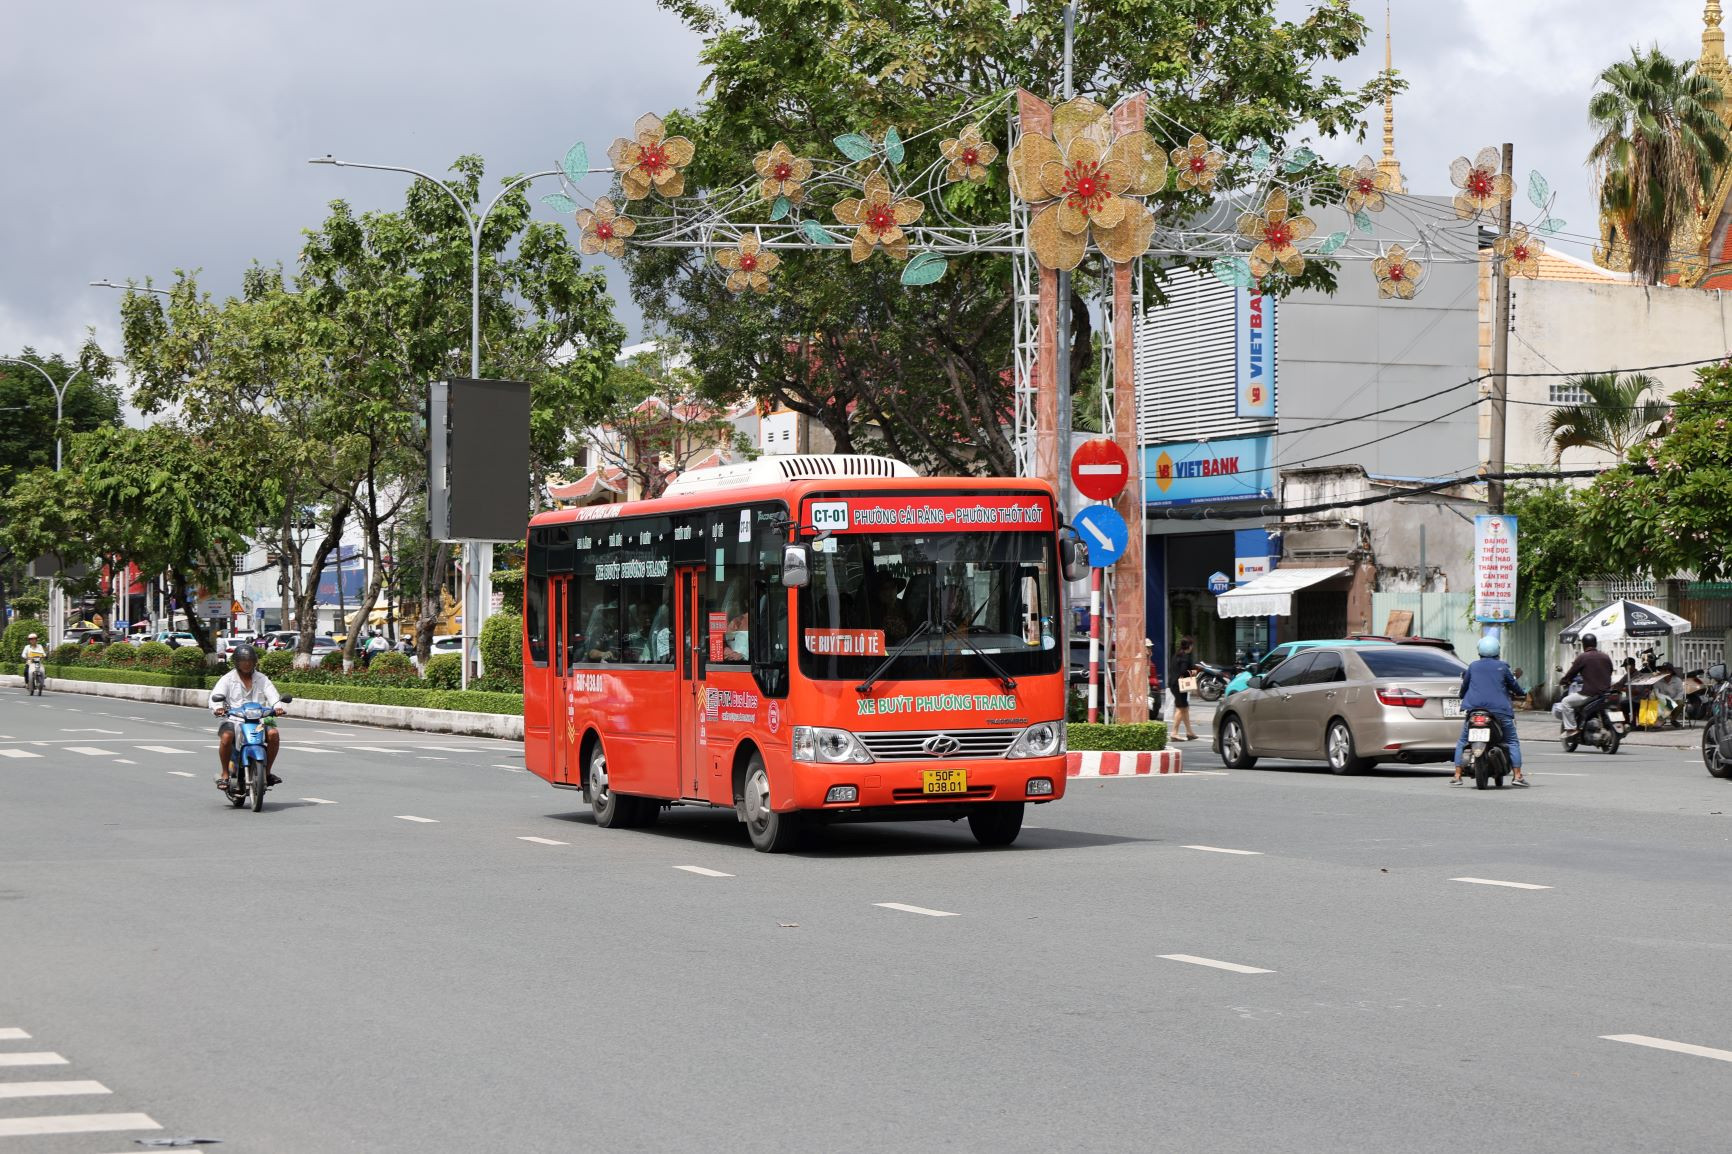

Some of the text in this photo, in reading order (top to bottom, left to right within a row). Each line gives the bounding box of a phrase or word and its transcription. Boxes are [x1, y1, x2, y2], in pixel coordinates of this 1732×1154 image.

[1175, 457, 1239, 478] VIETBANK
[814, 503, 1043, 525] CT-01 PHƯỜNG CÁI RĂNG PHƯỜNG THỐT NỐT
[1213, 583, 1228, 591] ATM
[819, 633, 840, 653] BUÝT
[857, 693, 1017, 715] XE BUÝT PHƯƠNG TRANG
[935, 771, 954, 781] 50F
[928, 781, 962, 793] 038.01
